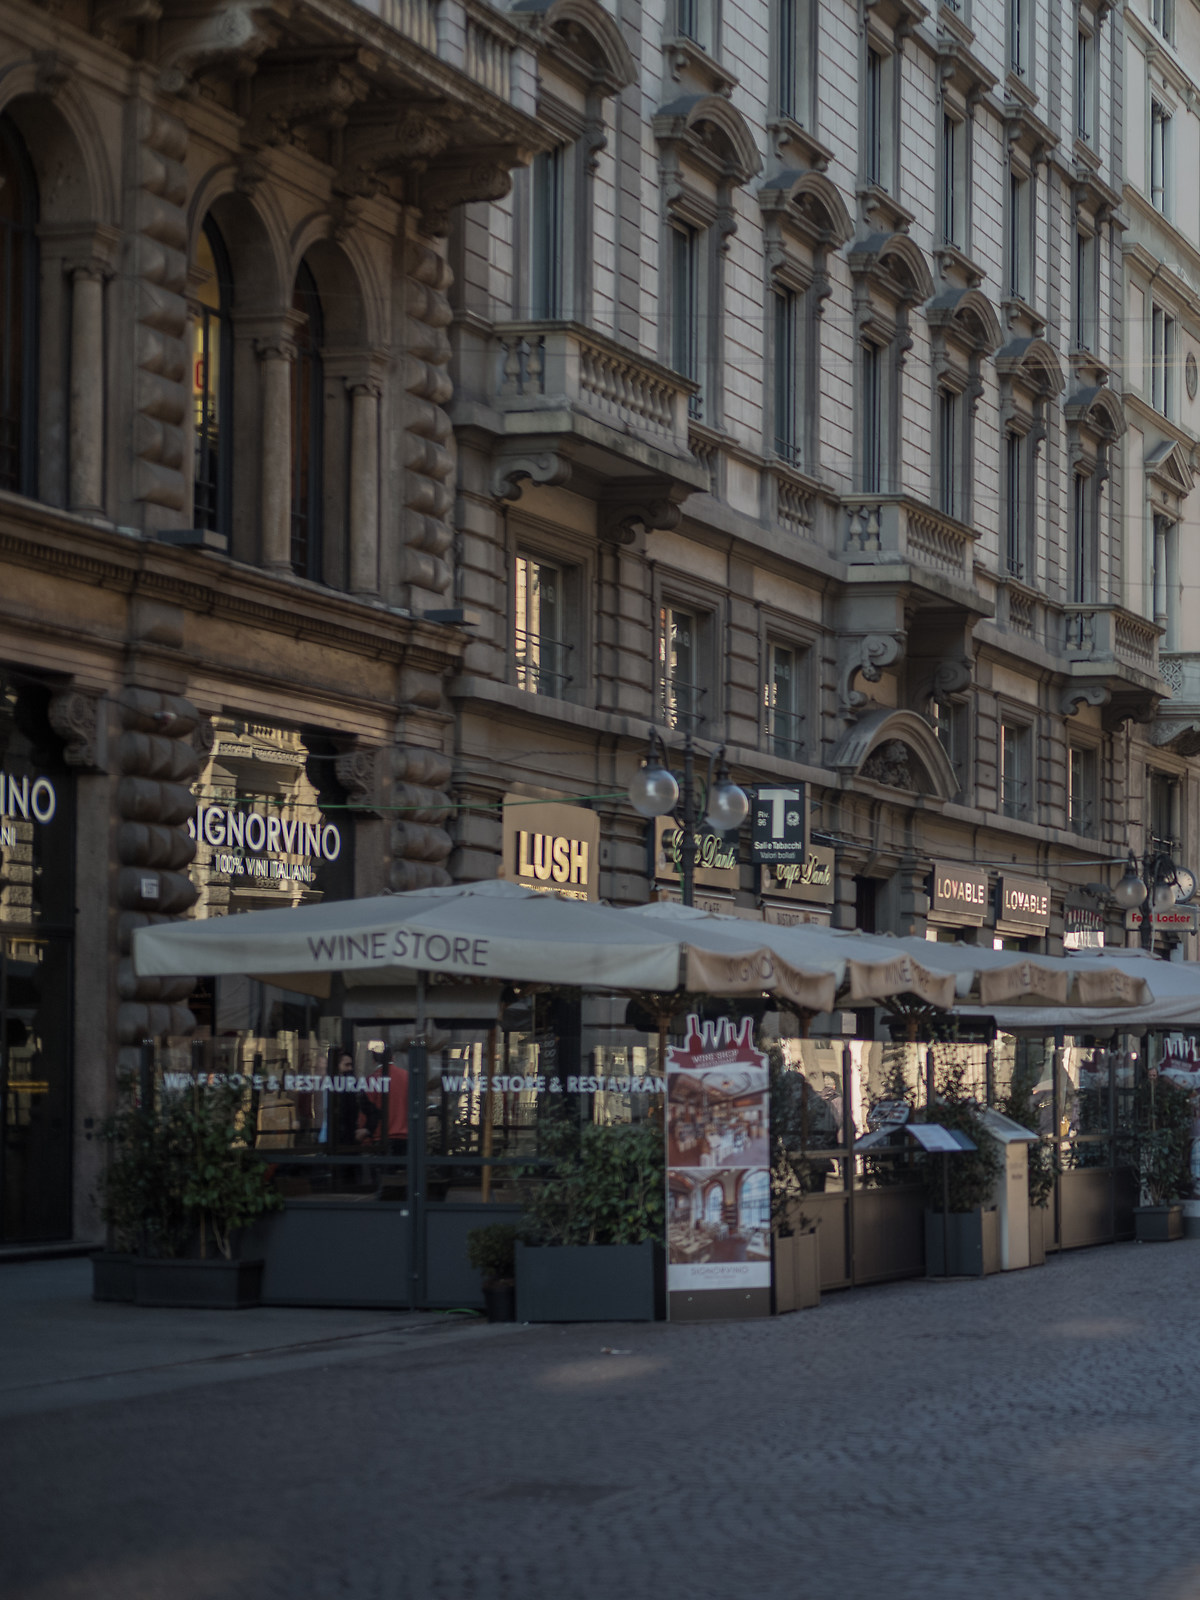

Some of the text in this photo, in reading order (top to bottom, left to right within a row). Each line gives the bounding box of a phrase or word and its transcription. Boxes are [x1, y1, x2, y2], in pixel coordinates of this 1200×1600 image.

[758, 788, 800, 838] T
[516, 829, 589, 885] LUSH
[772, 841, 802, 850] Tabacchi
[937, 878, 985, 904] LOVABLE
[1005, 889, 1048, 915] LOVABLE
[1131, 912, 1191, 923] Fot Locker
[307, 929, 491, 967] WINE STORE
[285, 1074, 391, 1093] RESTAURANT
[441, 1075, 488, 1092] WINE
[491, 1075, 546, 1093] STORE
[566, 1075, 667, 1093] RESTAURAN
